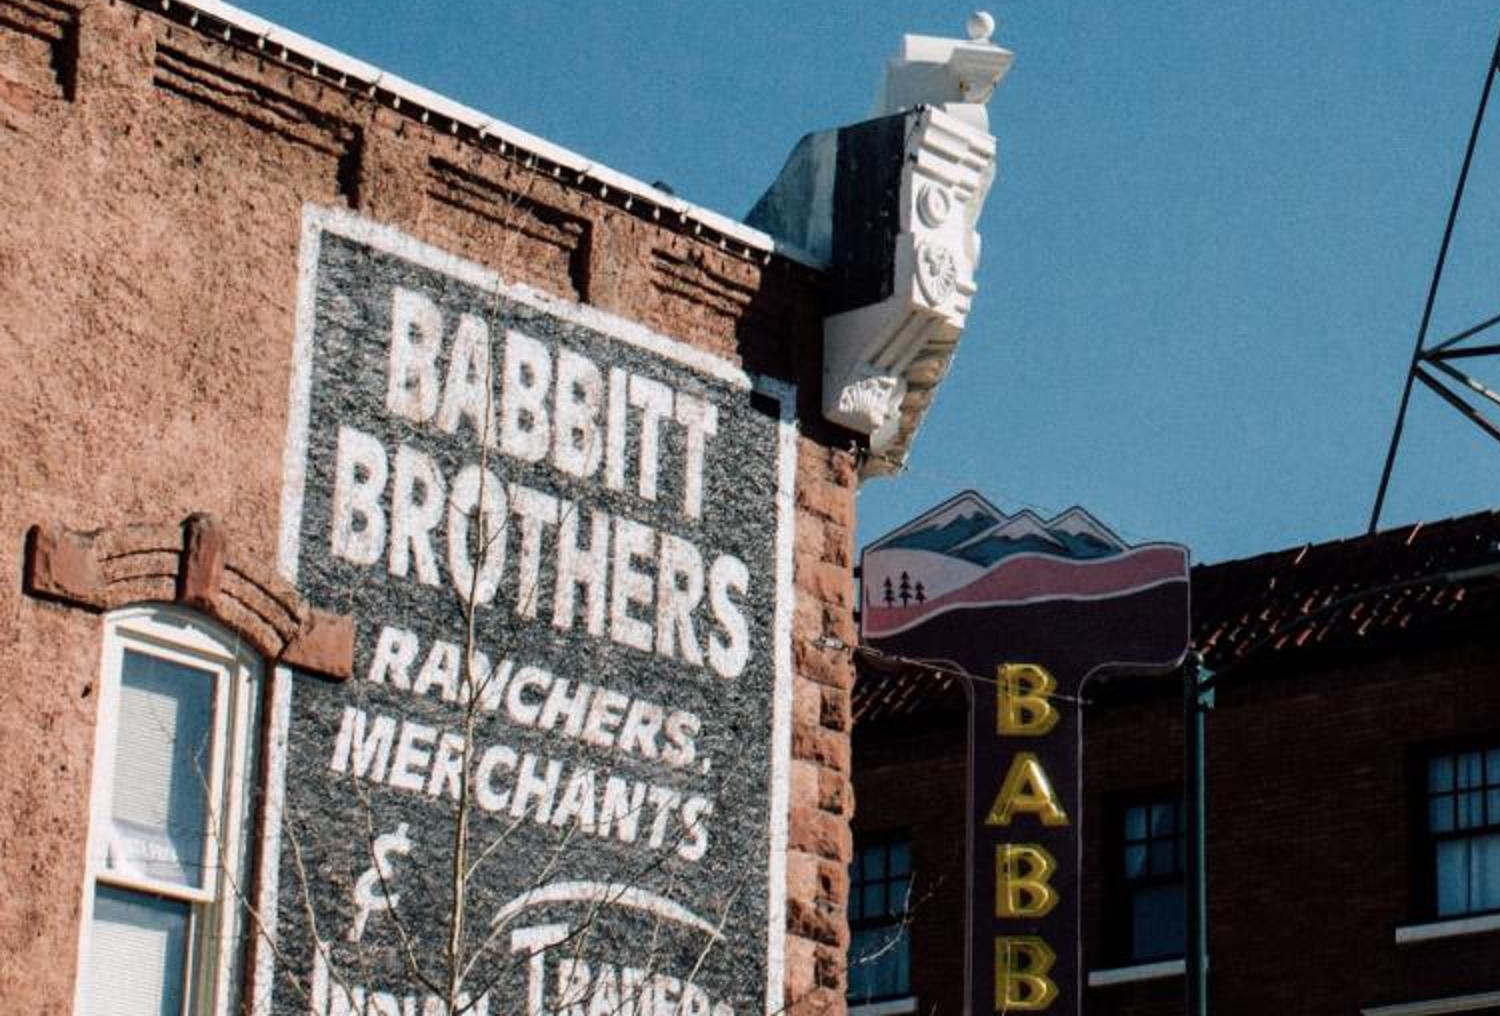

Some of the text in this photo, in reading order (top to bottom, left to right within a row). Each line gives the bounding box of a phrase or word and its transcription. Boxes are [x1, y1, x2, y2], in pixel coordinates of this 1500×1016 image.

[385, 285, 719, 521] BABBITT
[330, 424, 750, 681] BROTHERS
[330, 705, 713, 861] MERCHANTS
